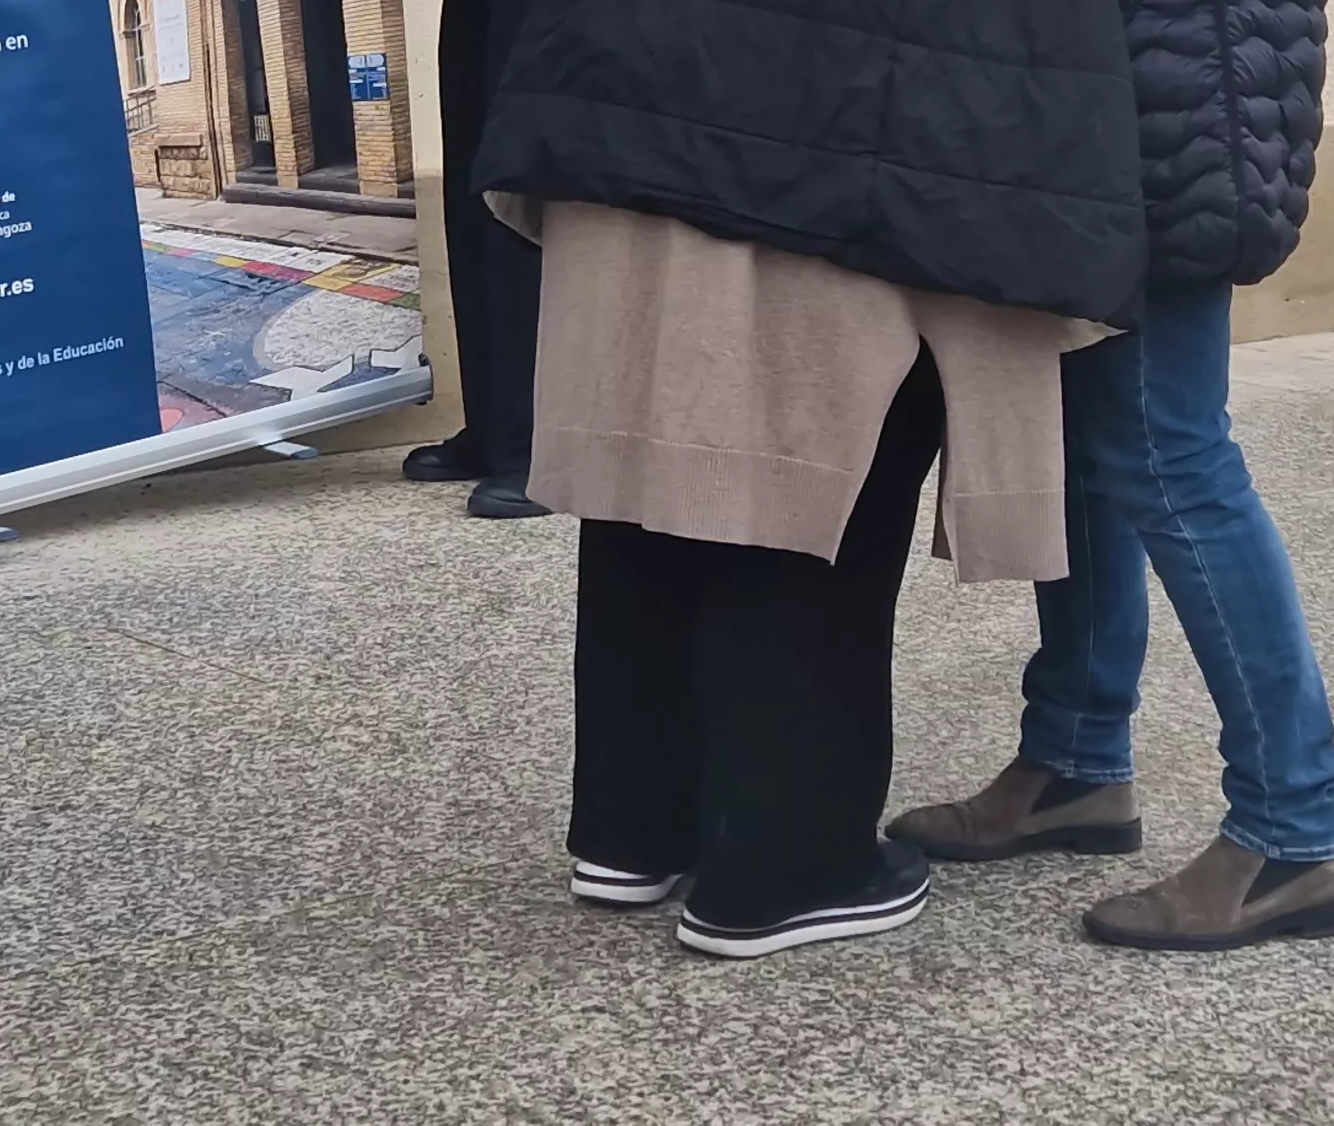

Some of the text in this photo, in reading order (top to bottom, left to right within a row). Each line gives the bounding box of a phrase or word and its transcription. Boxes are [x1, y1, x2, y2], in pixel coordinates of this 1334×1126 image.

[6, 35, 28, 50] en
[2, 191, 15, 202] de
[5, 362, 13, 376] y
[18, 356, 34, 369] de
[38, 352, 50, 365] la
[53, 336, 123, 362] Educación
